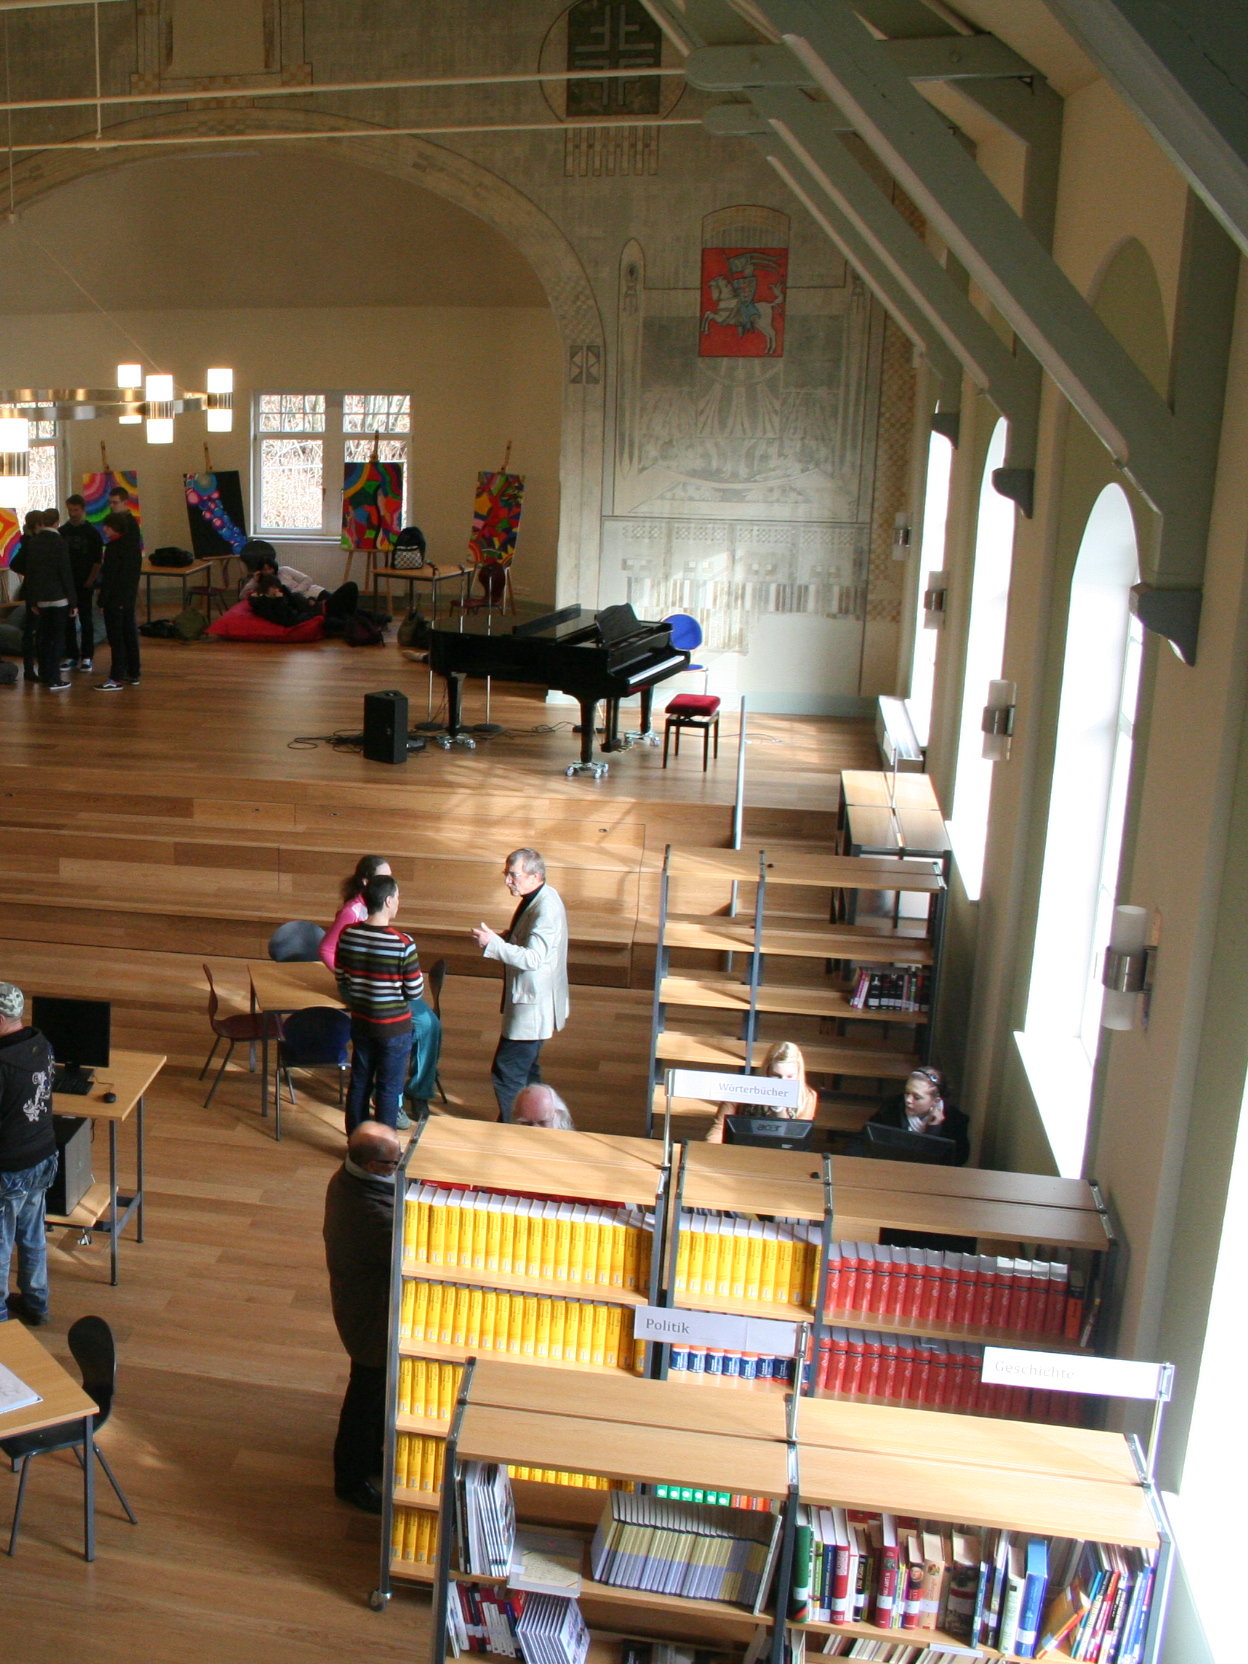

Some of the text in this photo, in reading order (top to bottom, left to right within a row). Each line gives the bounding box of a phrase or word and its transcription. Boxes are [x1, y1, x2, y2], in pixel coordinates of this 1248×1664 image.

[718, 1082, 789, 1098] Wörterbücher
[756, 1123, 782, 1132] acer
[646, 1317, 690, 1334] Politik
[994, 1360, 1075, 1380] Geschichte
